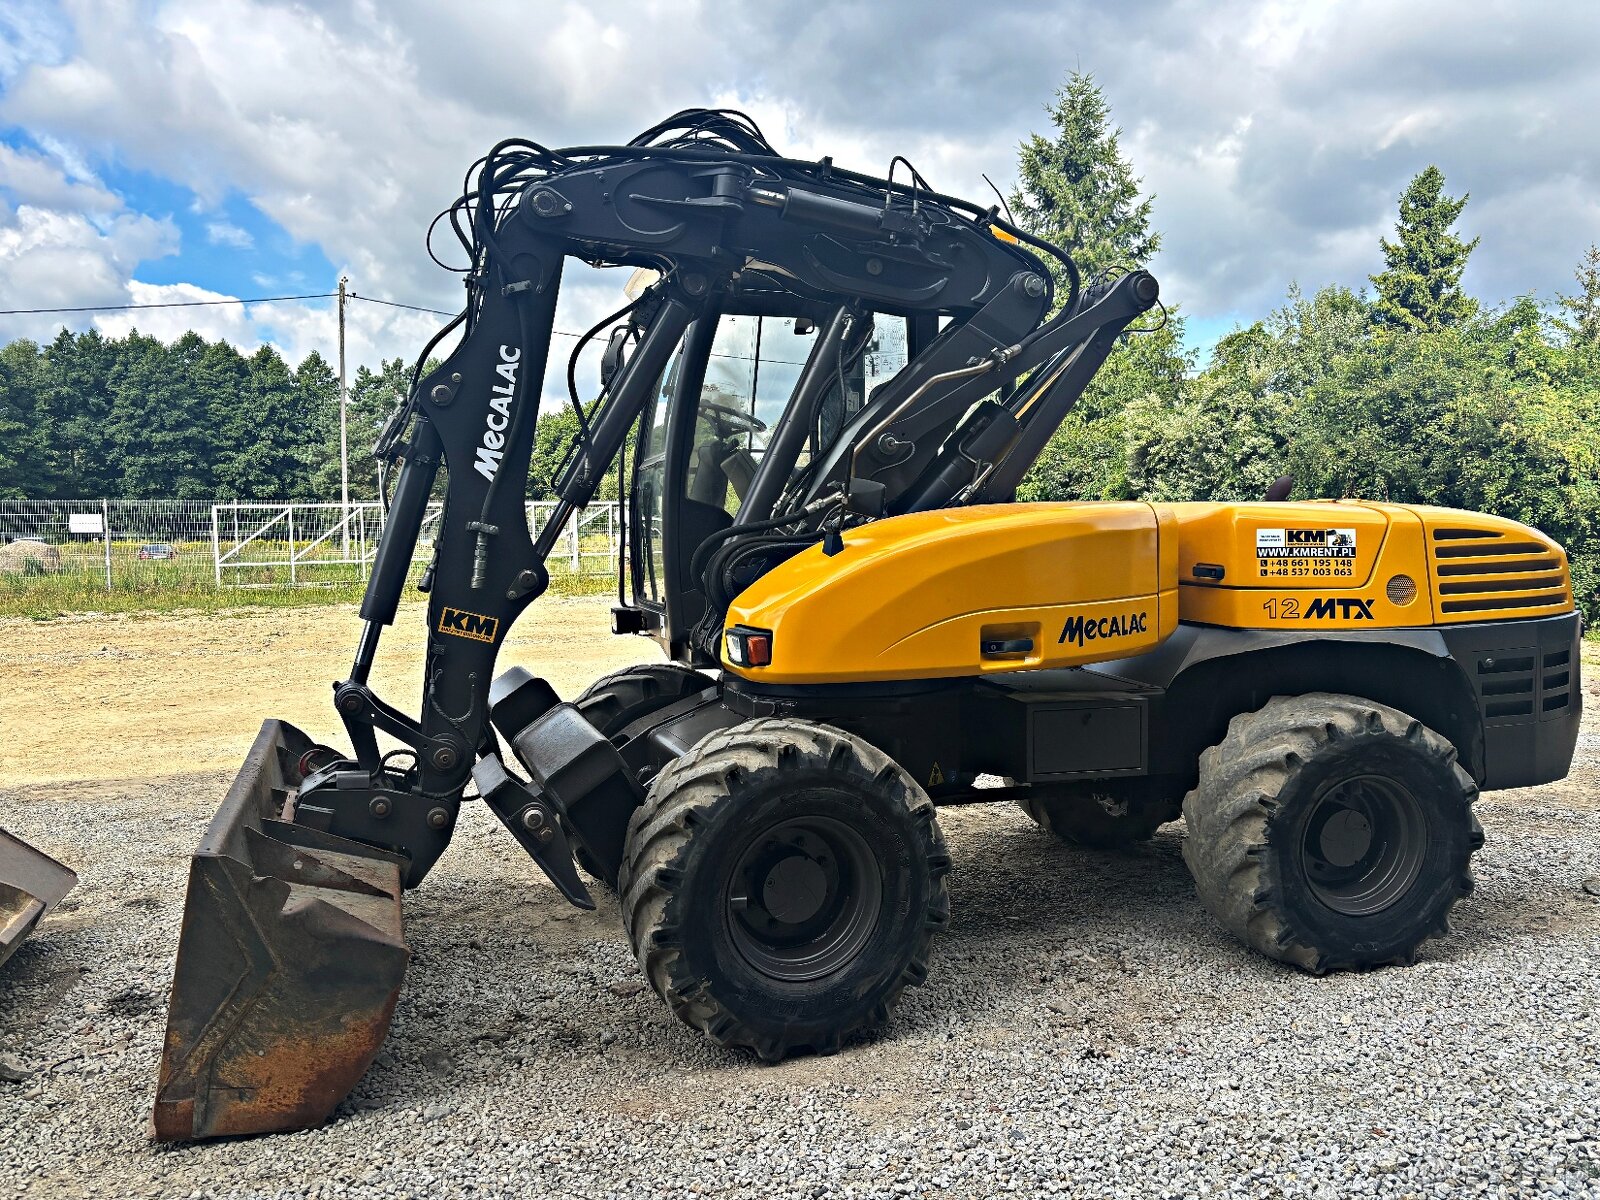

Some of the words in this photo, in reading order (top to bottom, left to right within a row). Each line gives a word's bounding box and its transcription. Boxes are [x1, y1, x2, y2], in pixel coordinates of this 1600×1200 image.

[1287, 530, 1325, 542] KM
[1257, 547, 1355, 557] WWW.KMRENT.PL
[1270, 559, 1288, 567] +48
[1291, 559, 1309, 567] 661
[1313, 559, 1331, 567] 195
[1334, 559, 1352, 567] 148
[1270, 568, 1288, 576] +48
[1291, 568, 1309, 576] 537
[1313, 568, 1331, 576] 003
[1334, 568, 1352, 576] 063
[1263, 598, 1300, 619] 12
[1303, 598, 1375, 620] MTX
[441, 609, 496, 636] KM
